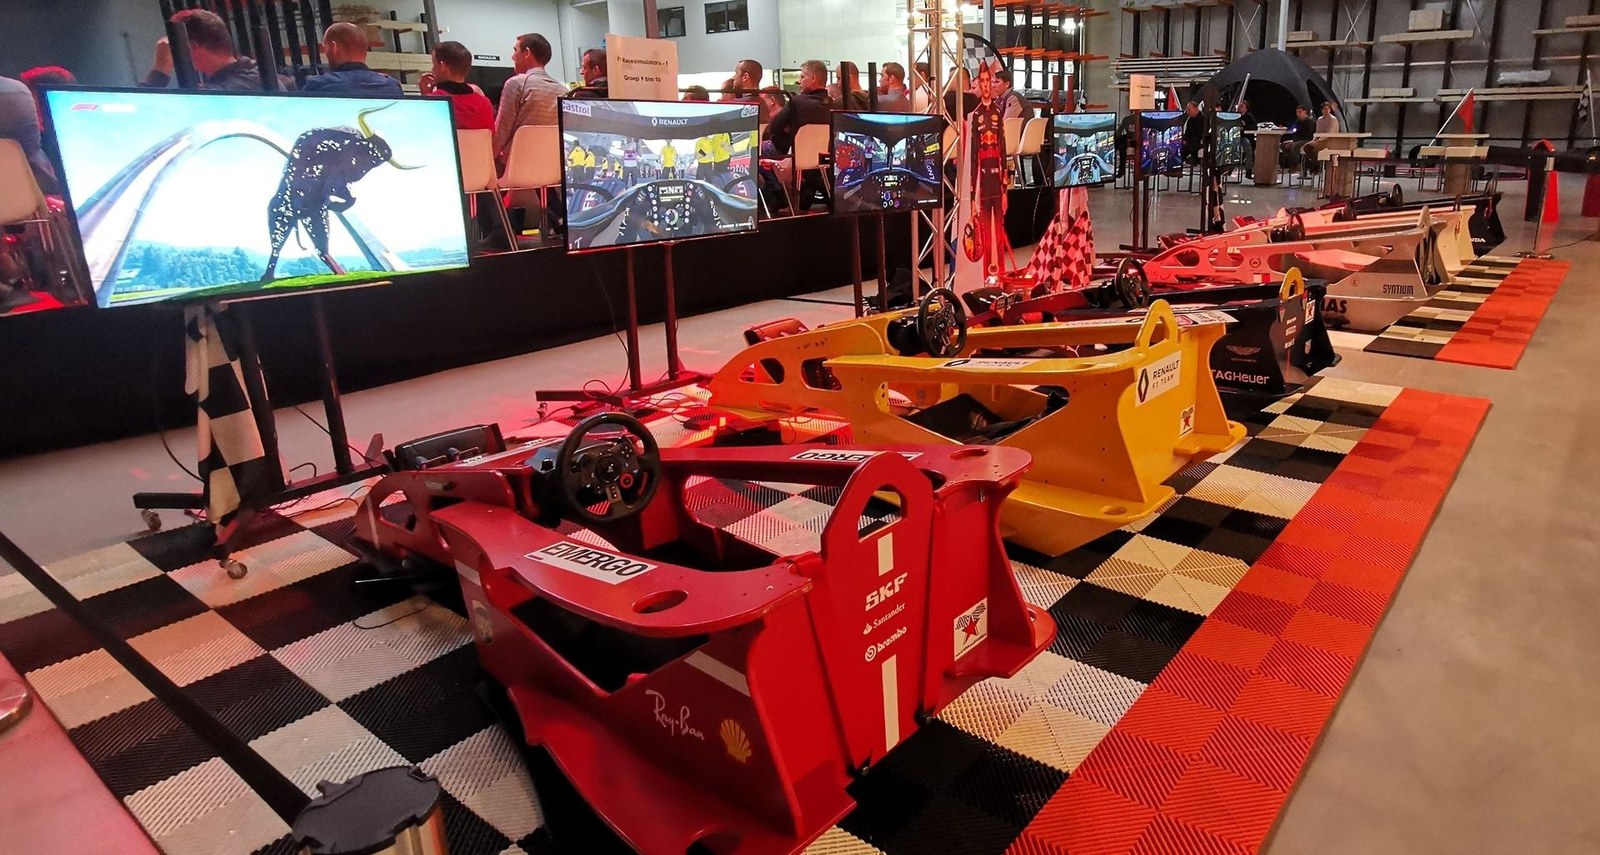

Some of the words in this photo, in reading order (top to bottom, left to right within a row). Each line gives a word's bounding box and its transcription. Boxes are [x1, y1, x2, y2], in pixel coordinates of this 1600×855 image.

[659, 118, 688, 126] RENAULT
[1382, 283, 1414, 295] SYNTIUM
[1152, 359, 1180, 380] RENAULT
[539, 542, 649, 577] EMERGO
[865, 572, 908, 612] SKF
[872, 602, 906, 629] Santander
[876, 626, 907, 654] brembo
